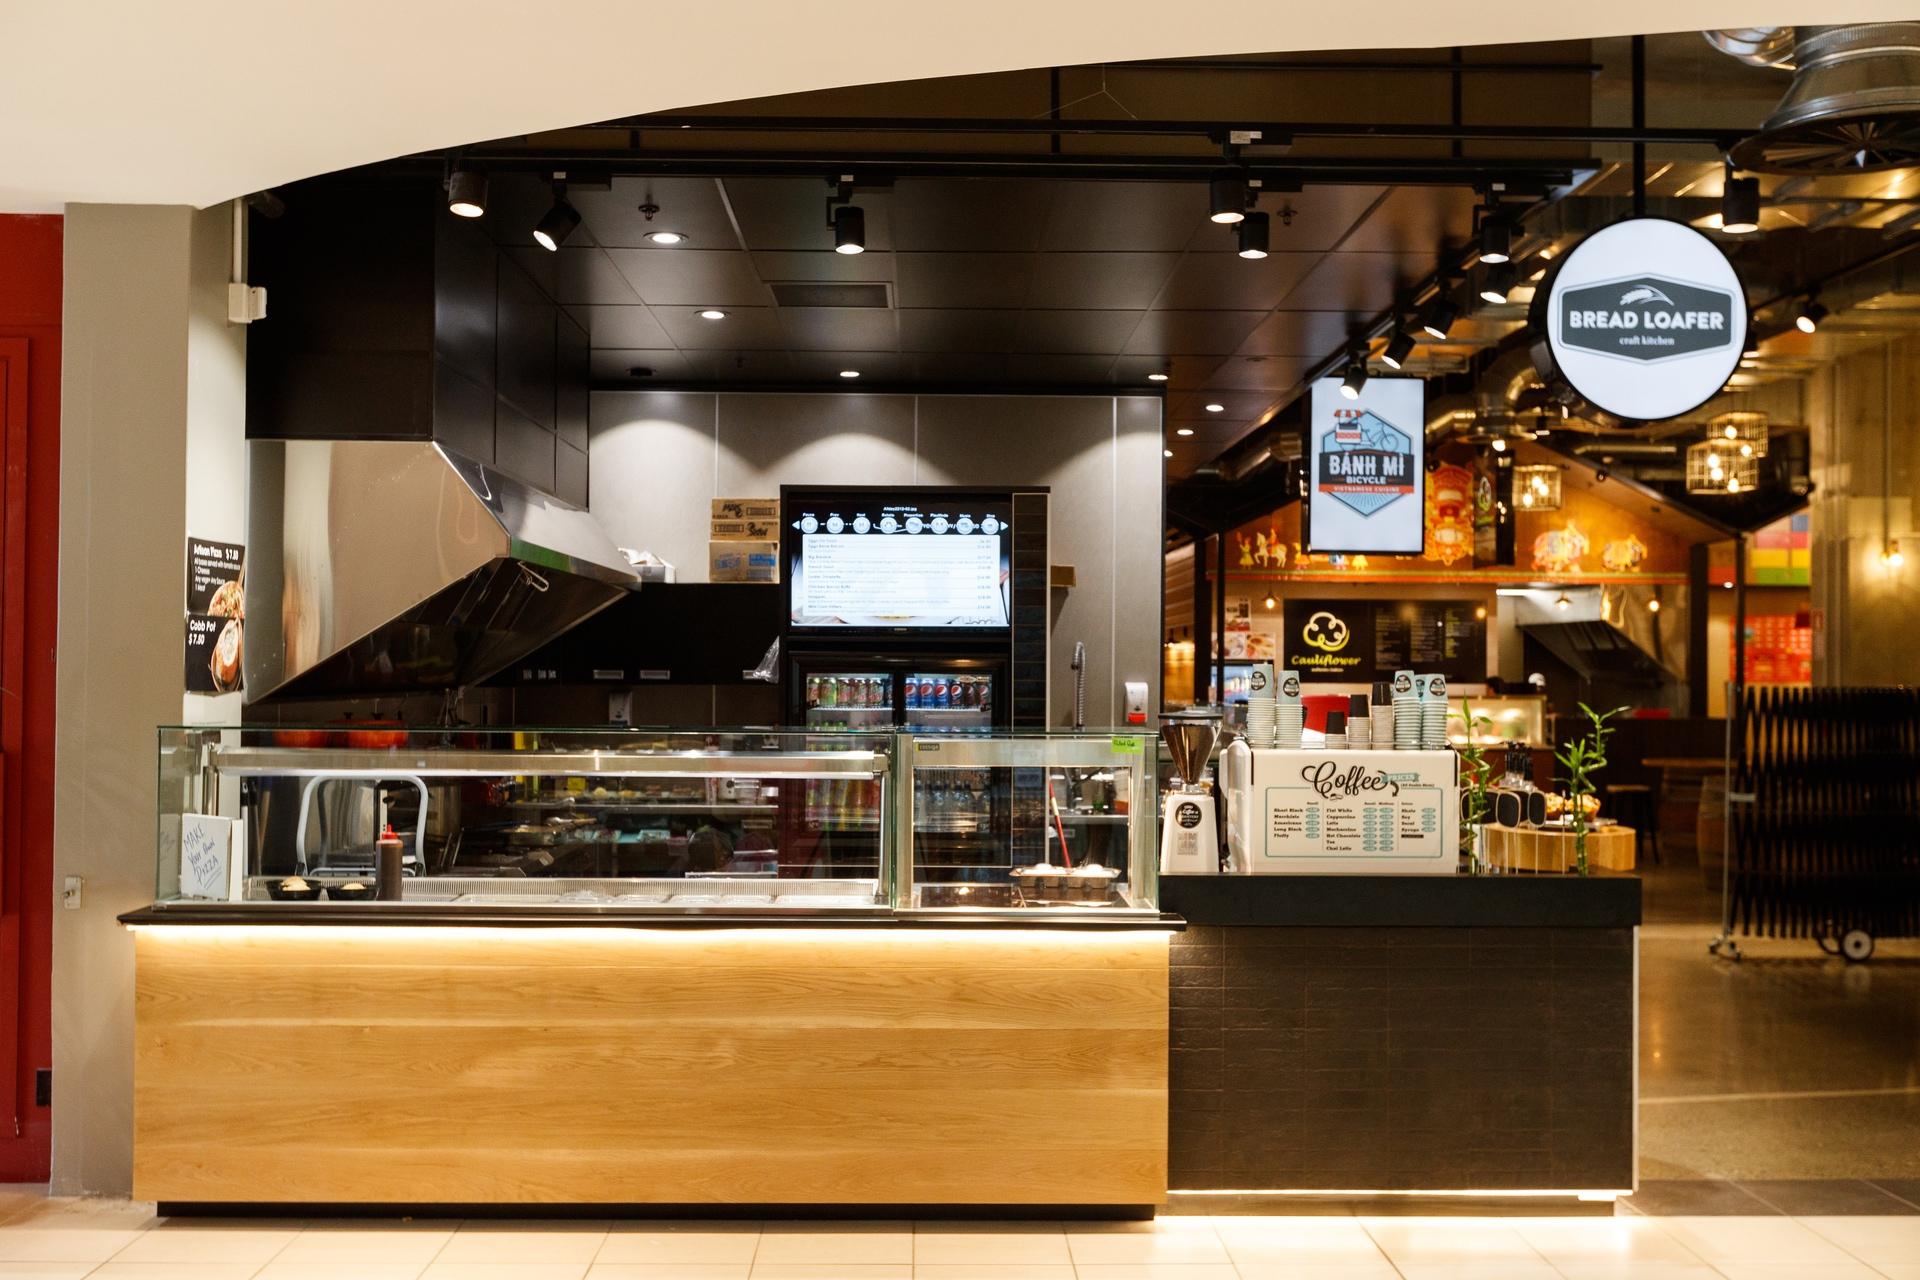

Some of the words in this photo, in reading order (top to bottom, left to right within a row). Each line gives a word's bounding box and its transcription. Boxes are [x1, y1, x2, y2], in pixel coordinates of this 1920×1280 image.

[1569, 310, 1639, 329] BREAD
[1643, 311, 1724, 330] LOAFER
[1619, 335, 1640, 345] craft
[1641, 335, 1675, 346] kitchen
[1345, 476, 1387, 484] BICYCLE
[1291, 654, 1362, 667] Cauliflower
[1302, 760, 1388, 799] Coffee
[184, 823, 205, 852] MAKE
